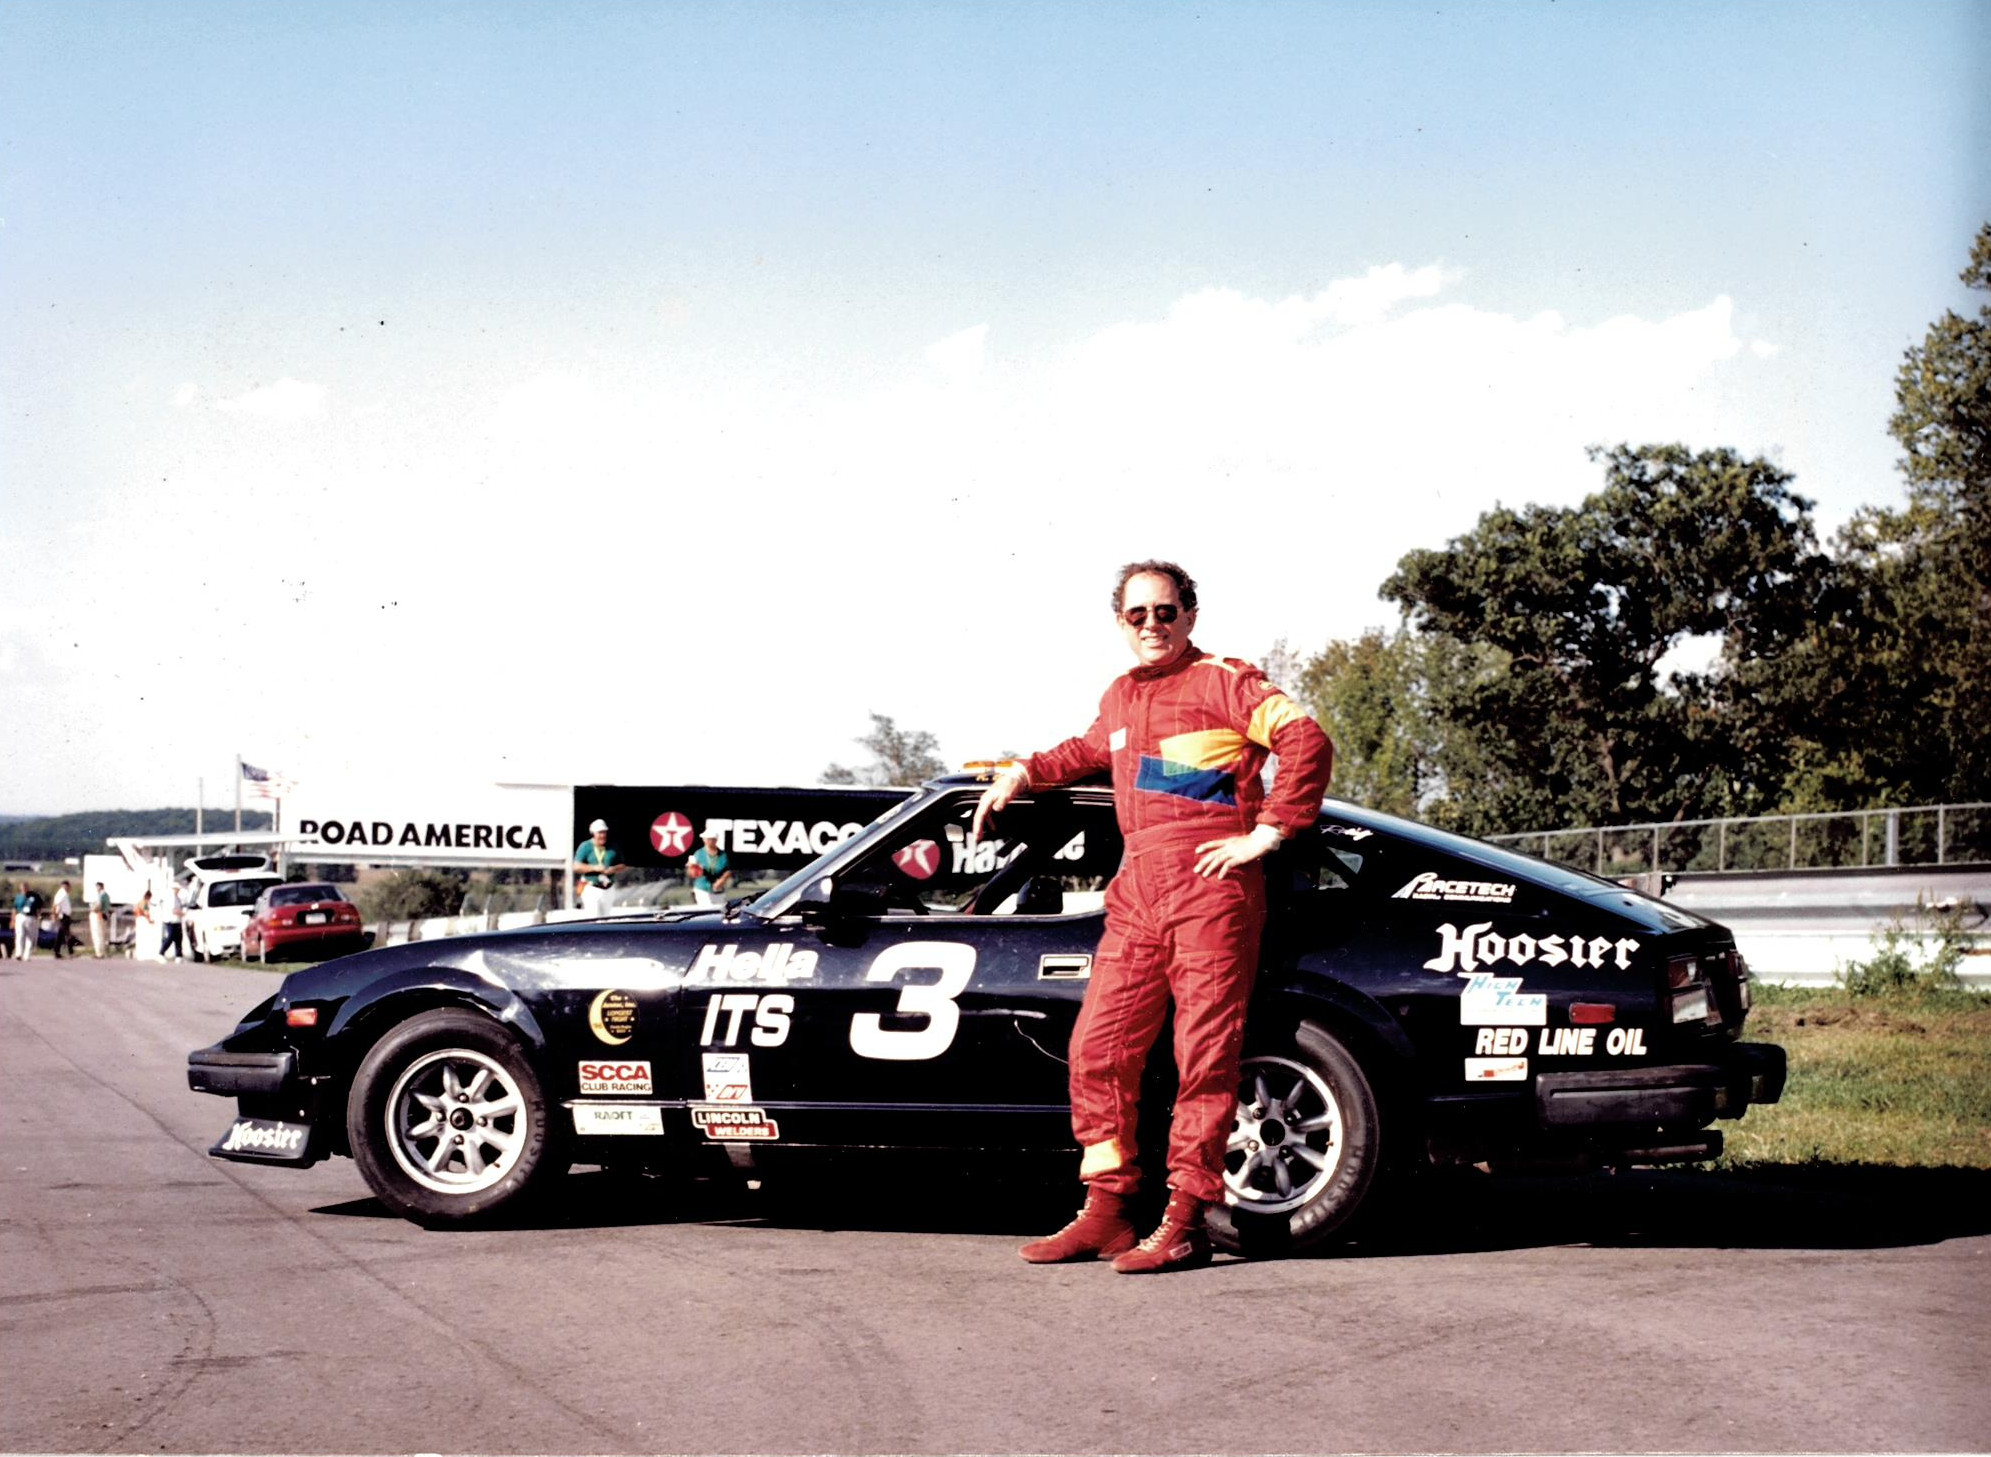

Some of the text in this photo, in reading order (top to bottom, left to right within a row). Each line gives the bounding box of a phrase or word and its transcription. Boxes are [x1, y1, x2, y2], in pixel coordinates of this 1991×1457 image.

[300, 819, 547, 850] ROAD AMERICA
[1423, 921, 1641, 971] Hoosier
[695, 943, 819, 981] Hella
[849, 940, 977, 1061] 3
[700, 994, 794, 1047] ITS
[1475, 1028, 1648, 1055] RED LINE OIL
[581, 1064, 649, 1081] SCCA
[581, 1082, 652, 1091] CLUB RACING
[697, 1112, 761, 1124] LINCOLN
[714, 1126, 770, 1137] WELDERS
